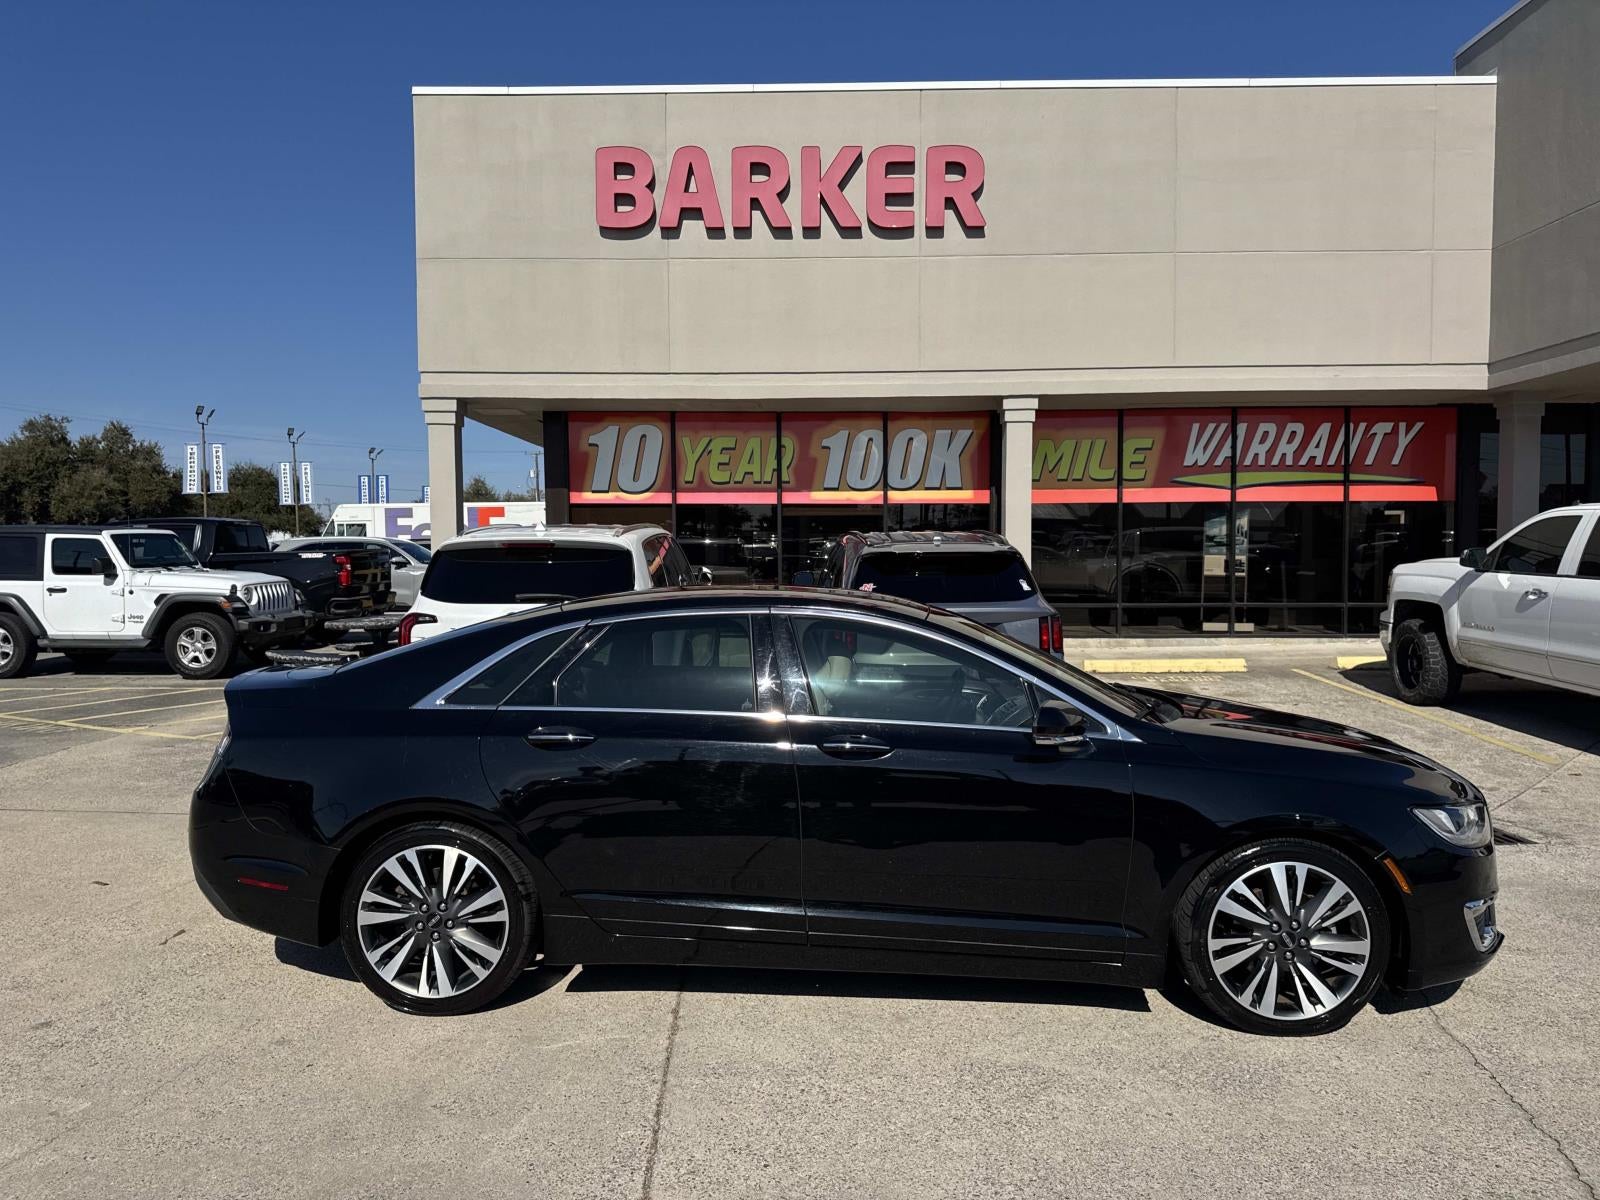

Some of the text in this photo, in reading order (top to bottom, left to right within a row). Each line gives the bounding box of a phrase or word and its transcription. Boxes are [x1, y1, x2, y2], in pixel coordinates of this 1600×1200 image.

[595, 145, 986, 231] BARKER
[588, 421, 1424, 494] 10 YEAR 100K MILE WARRANTY
